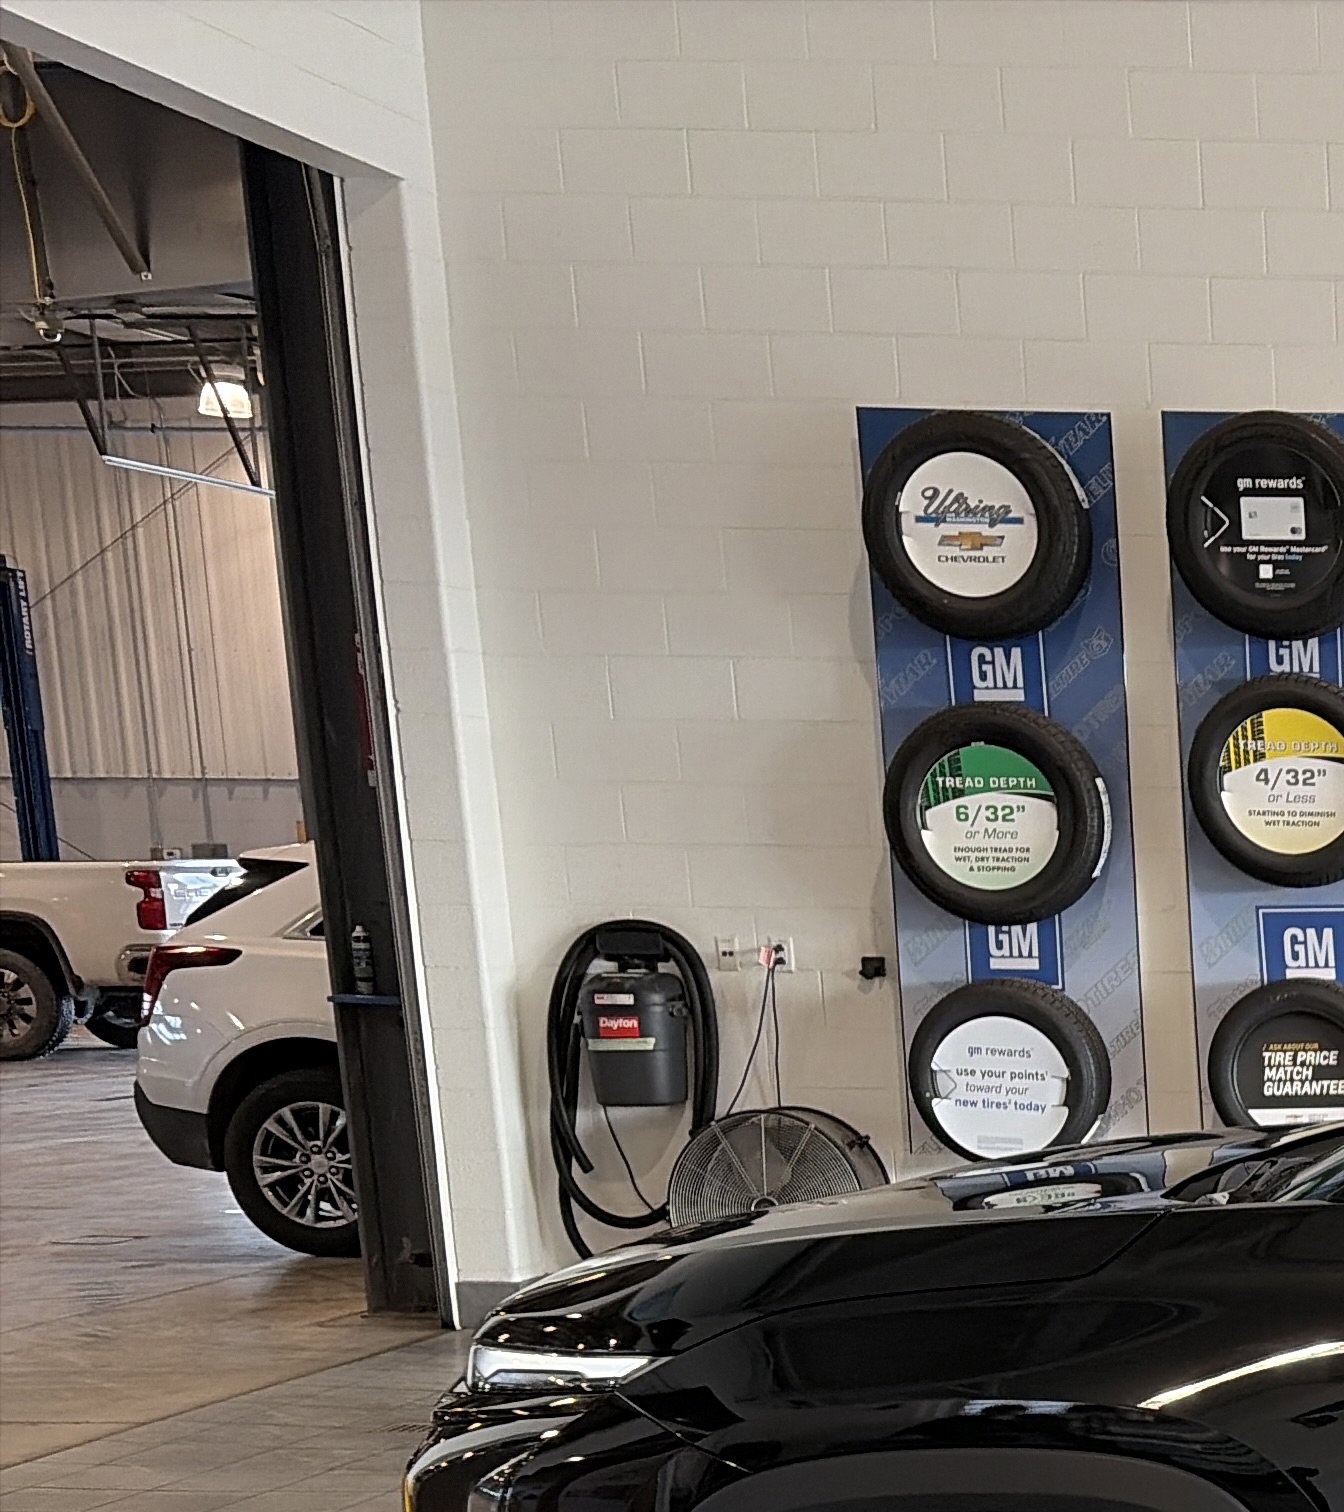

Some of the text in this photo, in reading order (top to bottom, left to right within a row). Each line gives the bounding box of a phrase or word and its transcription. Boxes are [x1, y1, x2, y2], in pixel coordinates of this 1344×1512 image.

[1237, 478, 1253, 491] gm
[937, 555, 1006, 564] CHEVROLET
[1268, 637, 1319, 673] GM
[971, 646, 1024, 689] GM
[1239, 740, 1339, 752] TREAD DEPTH
[936, 777, 1036, 789] TREAD DEPTH
[1267, 793, 1316, 804] or Less
[1299, 810, 1336, 818] DIMINISH
[965, 827, 1018, 839] or More
[953, 846, 1031, 854] ENOUGH TREAD FOR
[955, 856, 1030, 864] WET, DRY TRACTION
[976, 865, 1016, 873] STOPPING
[987, 921, 1039, 958] GM
[1284, 928, 1335, 968] GM
[599, 1017, 638, 1030] Dayton
[967, 1045, 982, 1058] gm
[1263, 1051, 1339, 1066] TIRE PRICE
[956, 1068, 976, 1077] use
[980, 1069, 1006, 1082] your
[1264, 1067, 1313, 1081] MATCH
[965, 1082, 1029, 1096] toward your
[954, 1099, 977, 1109] new
[1014, 1099, 1047, 1115] today
